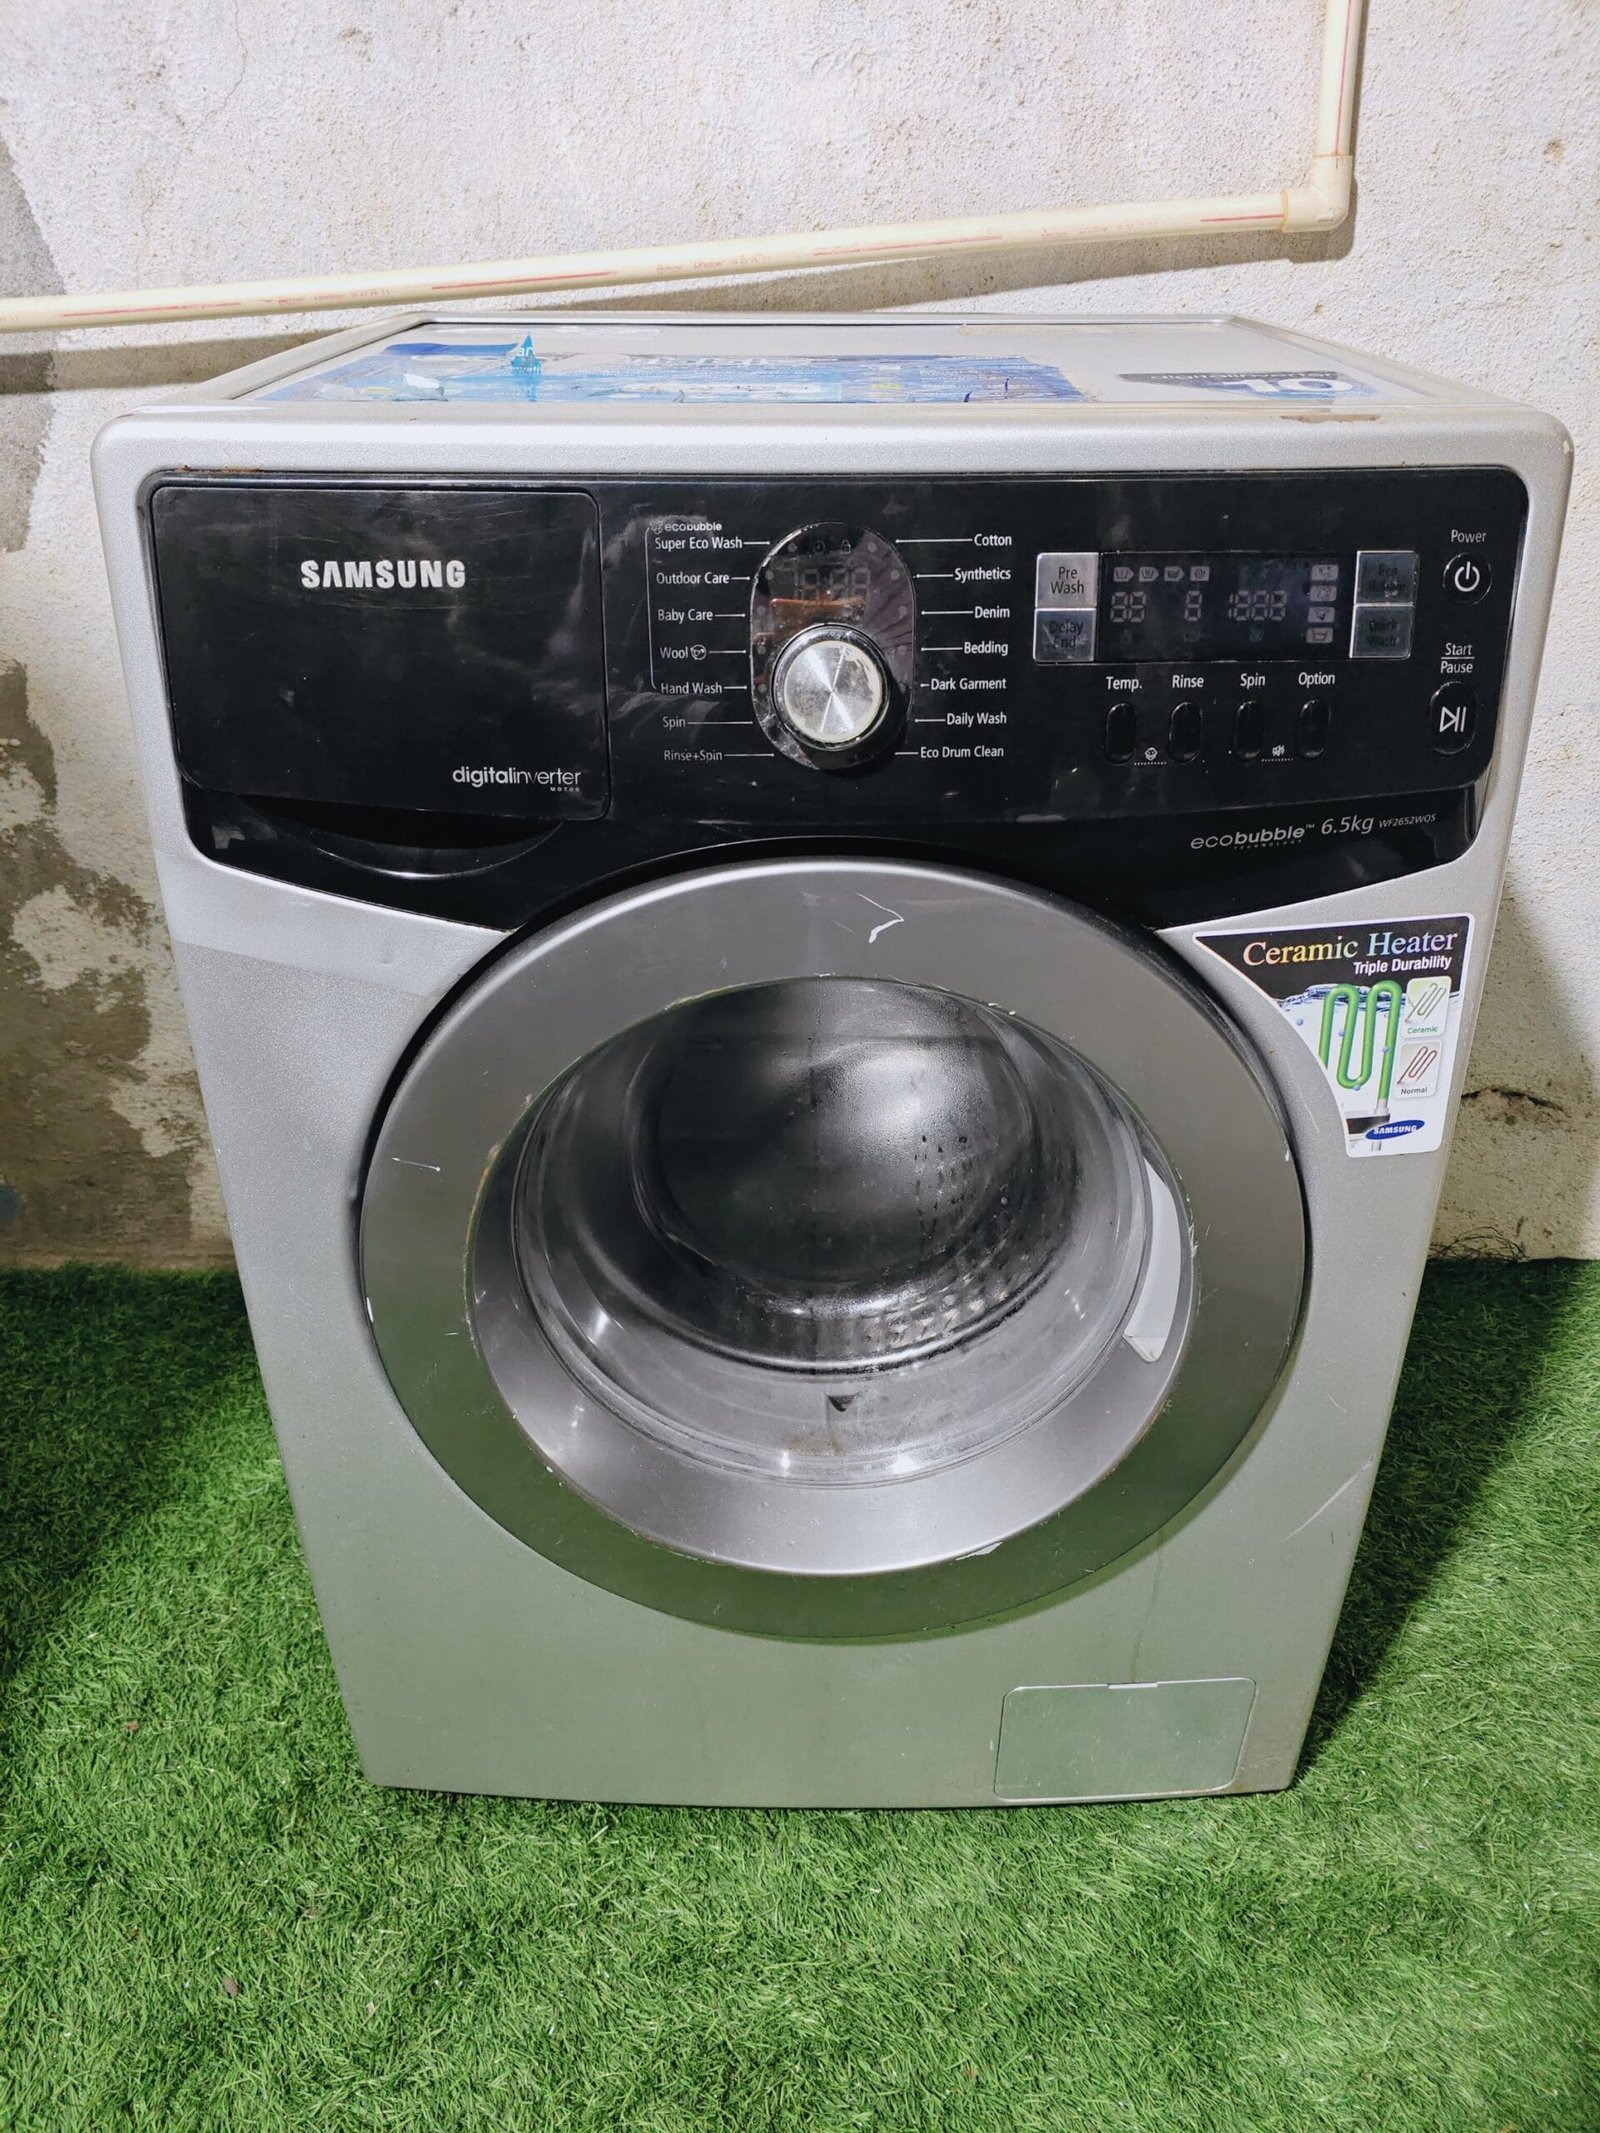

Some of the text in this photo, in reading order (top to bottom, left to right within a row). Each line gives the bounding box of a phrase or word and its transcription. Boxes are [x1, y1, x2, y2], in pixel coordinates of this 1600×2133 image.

[664, 522, 722, 532] ecobubble
[974, 533, 1012, 546] Cotton
[1451, 529, 1487, 543] Power
[655, 536, 743, 552] Super Eco Wash
[300, 559, 466, 589] SAMSUNG
[656, 572, 730, 585] Outdoor Care
[954, 567, 1011, 584] Synthetics
[1058, 566, 1078, 580] Pre
[1051, 581, 1085, 595] Wash
[658, 608, 713, 624] Baby Care
[974, 605, 1010, 619] Denim
[660, 646, 688, 659] Wool
[964, 641, 1009, 657] Bedding
[1445, 642, 1473, 656] Start
[1440, 660, 1473, 674] Pause
[931, 677, 1007, 691] Dark Garment
[1106, 676, 1143, 692] Temp.
[1172, 675, 1204, 688] Rinse
[1240, 672, 1266, 689] Spin
[1298, 672, 1336, 688] Option
[660, 681, 723, 694] Hand Wash
[662, 716, 686, 731] Spin
[947, 711, 1007, 728] Daily Wash
[663, 749, 723, 762] Rinse+Spin
[920, 745, 1004, 759] Eco Drum Clean
[1321, 815, 1374, 835] 6.5kg
[1242, 931, 1458, 967] Ceramic Heater
[1353, 954, 1452, 976] Triple Durability
[1407, 1025, 1439, 1034] Ceramic
[1400, 1086, 1428, 1095] Normal
[1373, 1124, 1418, 1135] SAMSUNG
